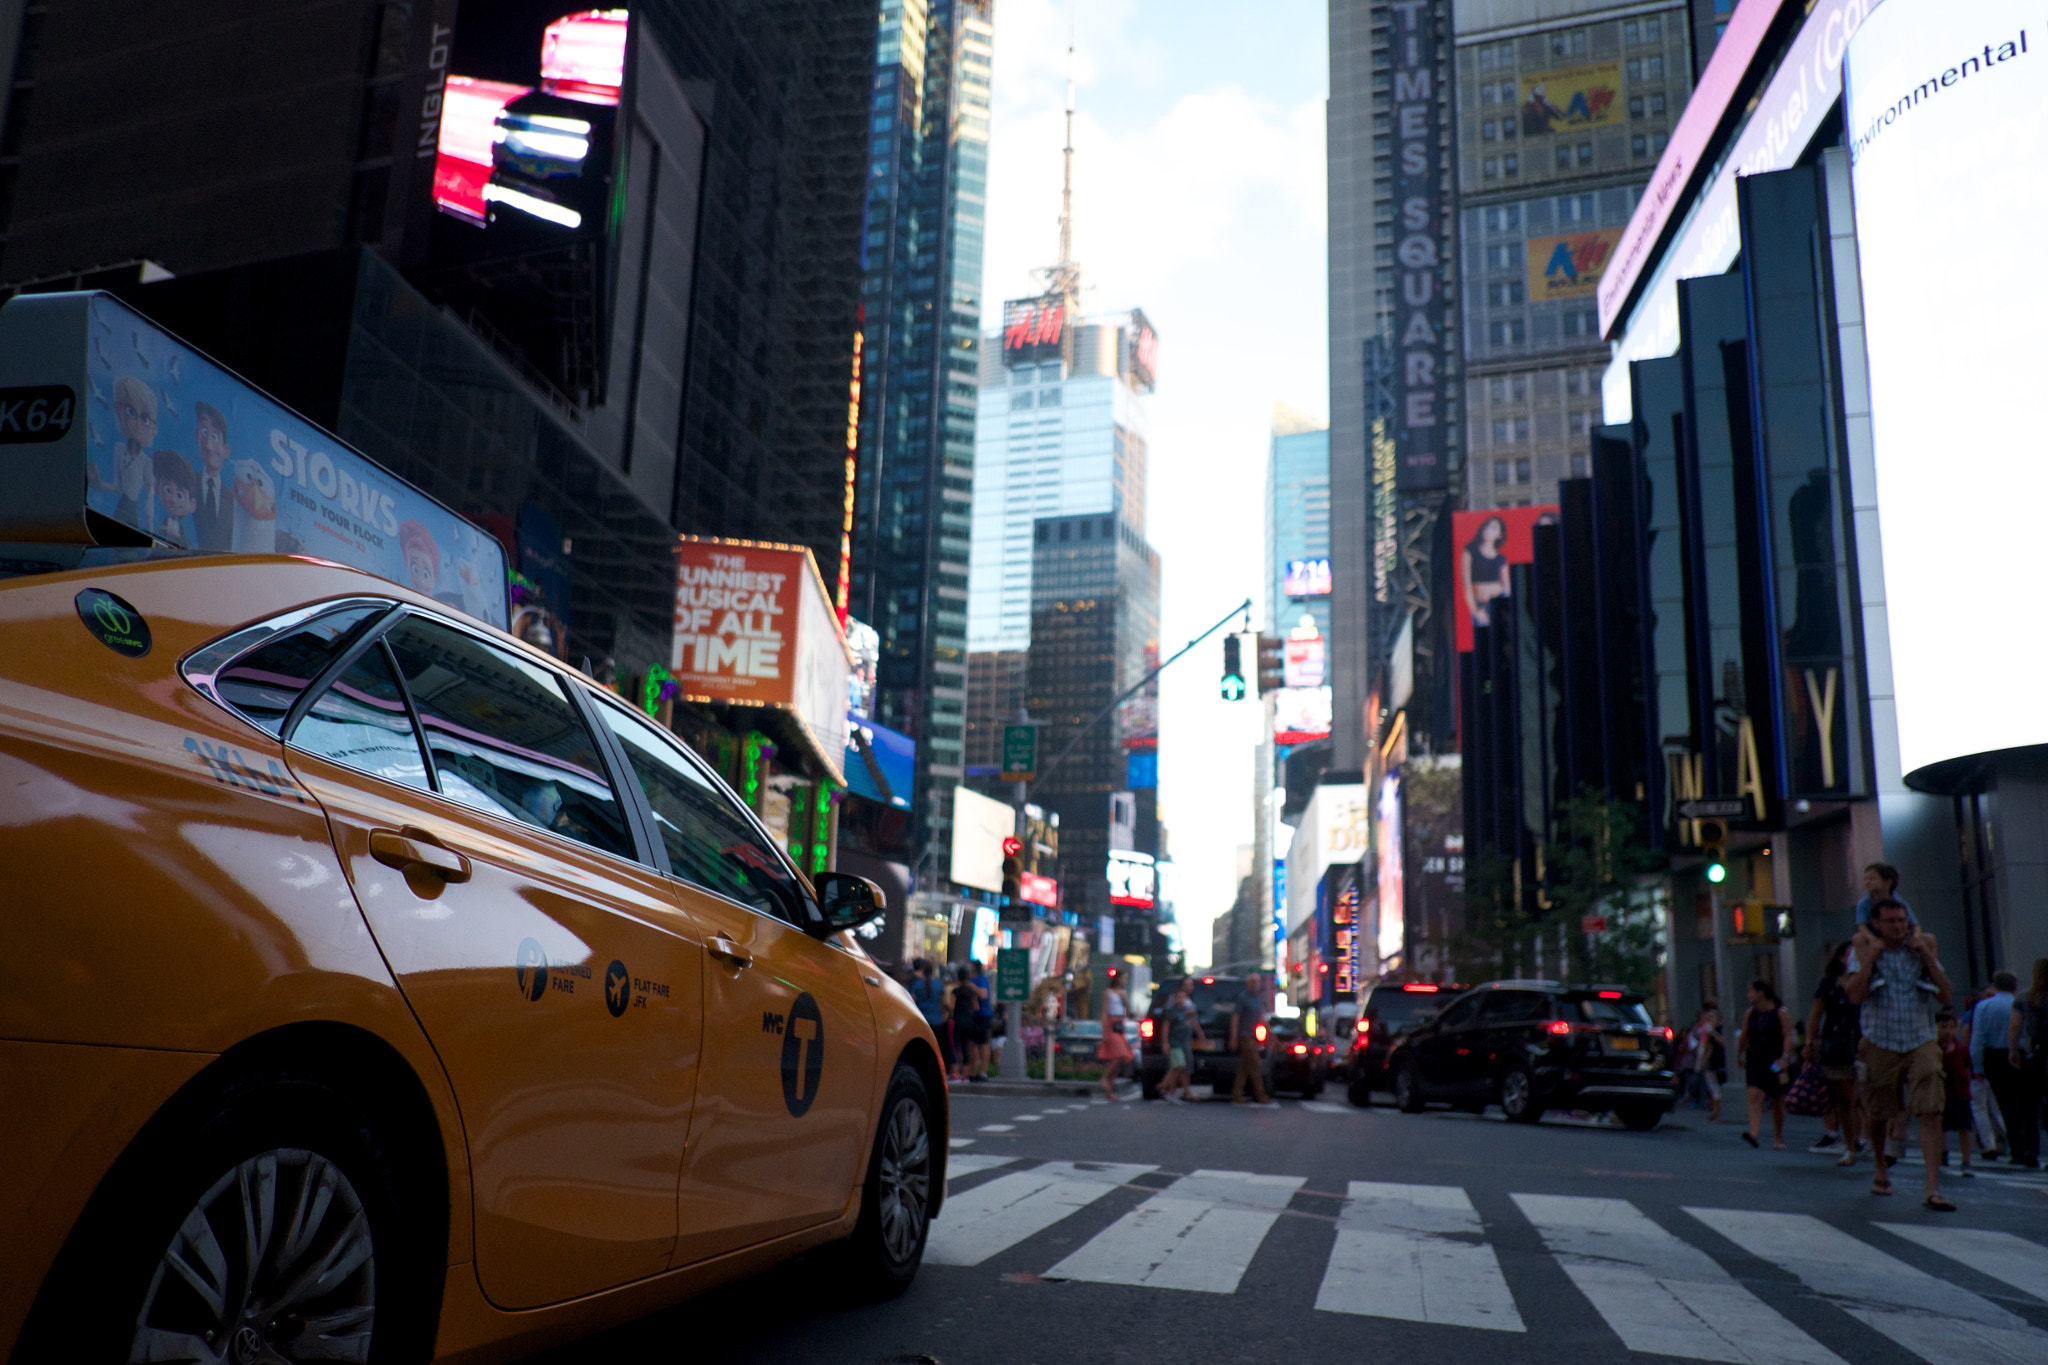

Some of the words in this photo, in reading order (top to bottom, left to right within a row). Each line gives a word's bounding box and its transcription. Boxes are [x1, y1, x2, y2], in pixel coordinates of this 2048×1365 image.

[417, 23, 451, 159] INGLOT
[1392, 1, 1432, 176] TIMES
[1398, 196, 1438, 428] SQUARE
[270, 429, 398, 537] STORKS
[290, 488, 317, 512] FIND
[320, 504, 350, 531] YOUR
[354, 523, 384, 550] FLOCK
[680, 565, 786, 594] UNNIEST
[717, 611, 782, 639] ALL
[183, 736, 305, 804] 1K64
[553, 957, 592, 979] METERED
[553, 977, 575, 994] FARE
[634, 978, 651, 994] FLAT
[652, 982, 671, 998] FARE
[633, 995, 647, 1009] JFK
[762, 1011, 784, 1035] NYC
